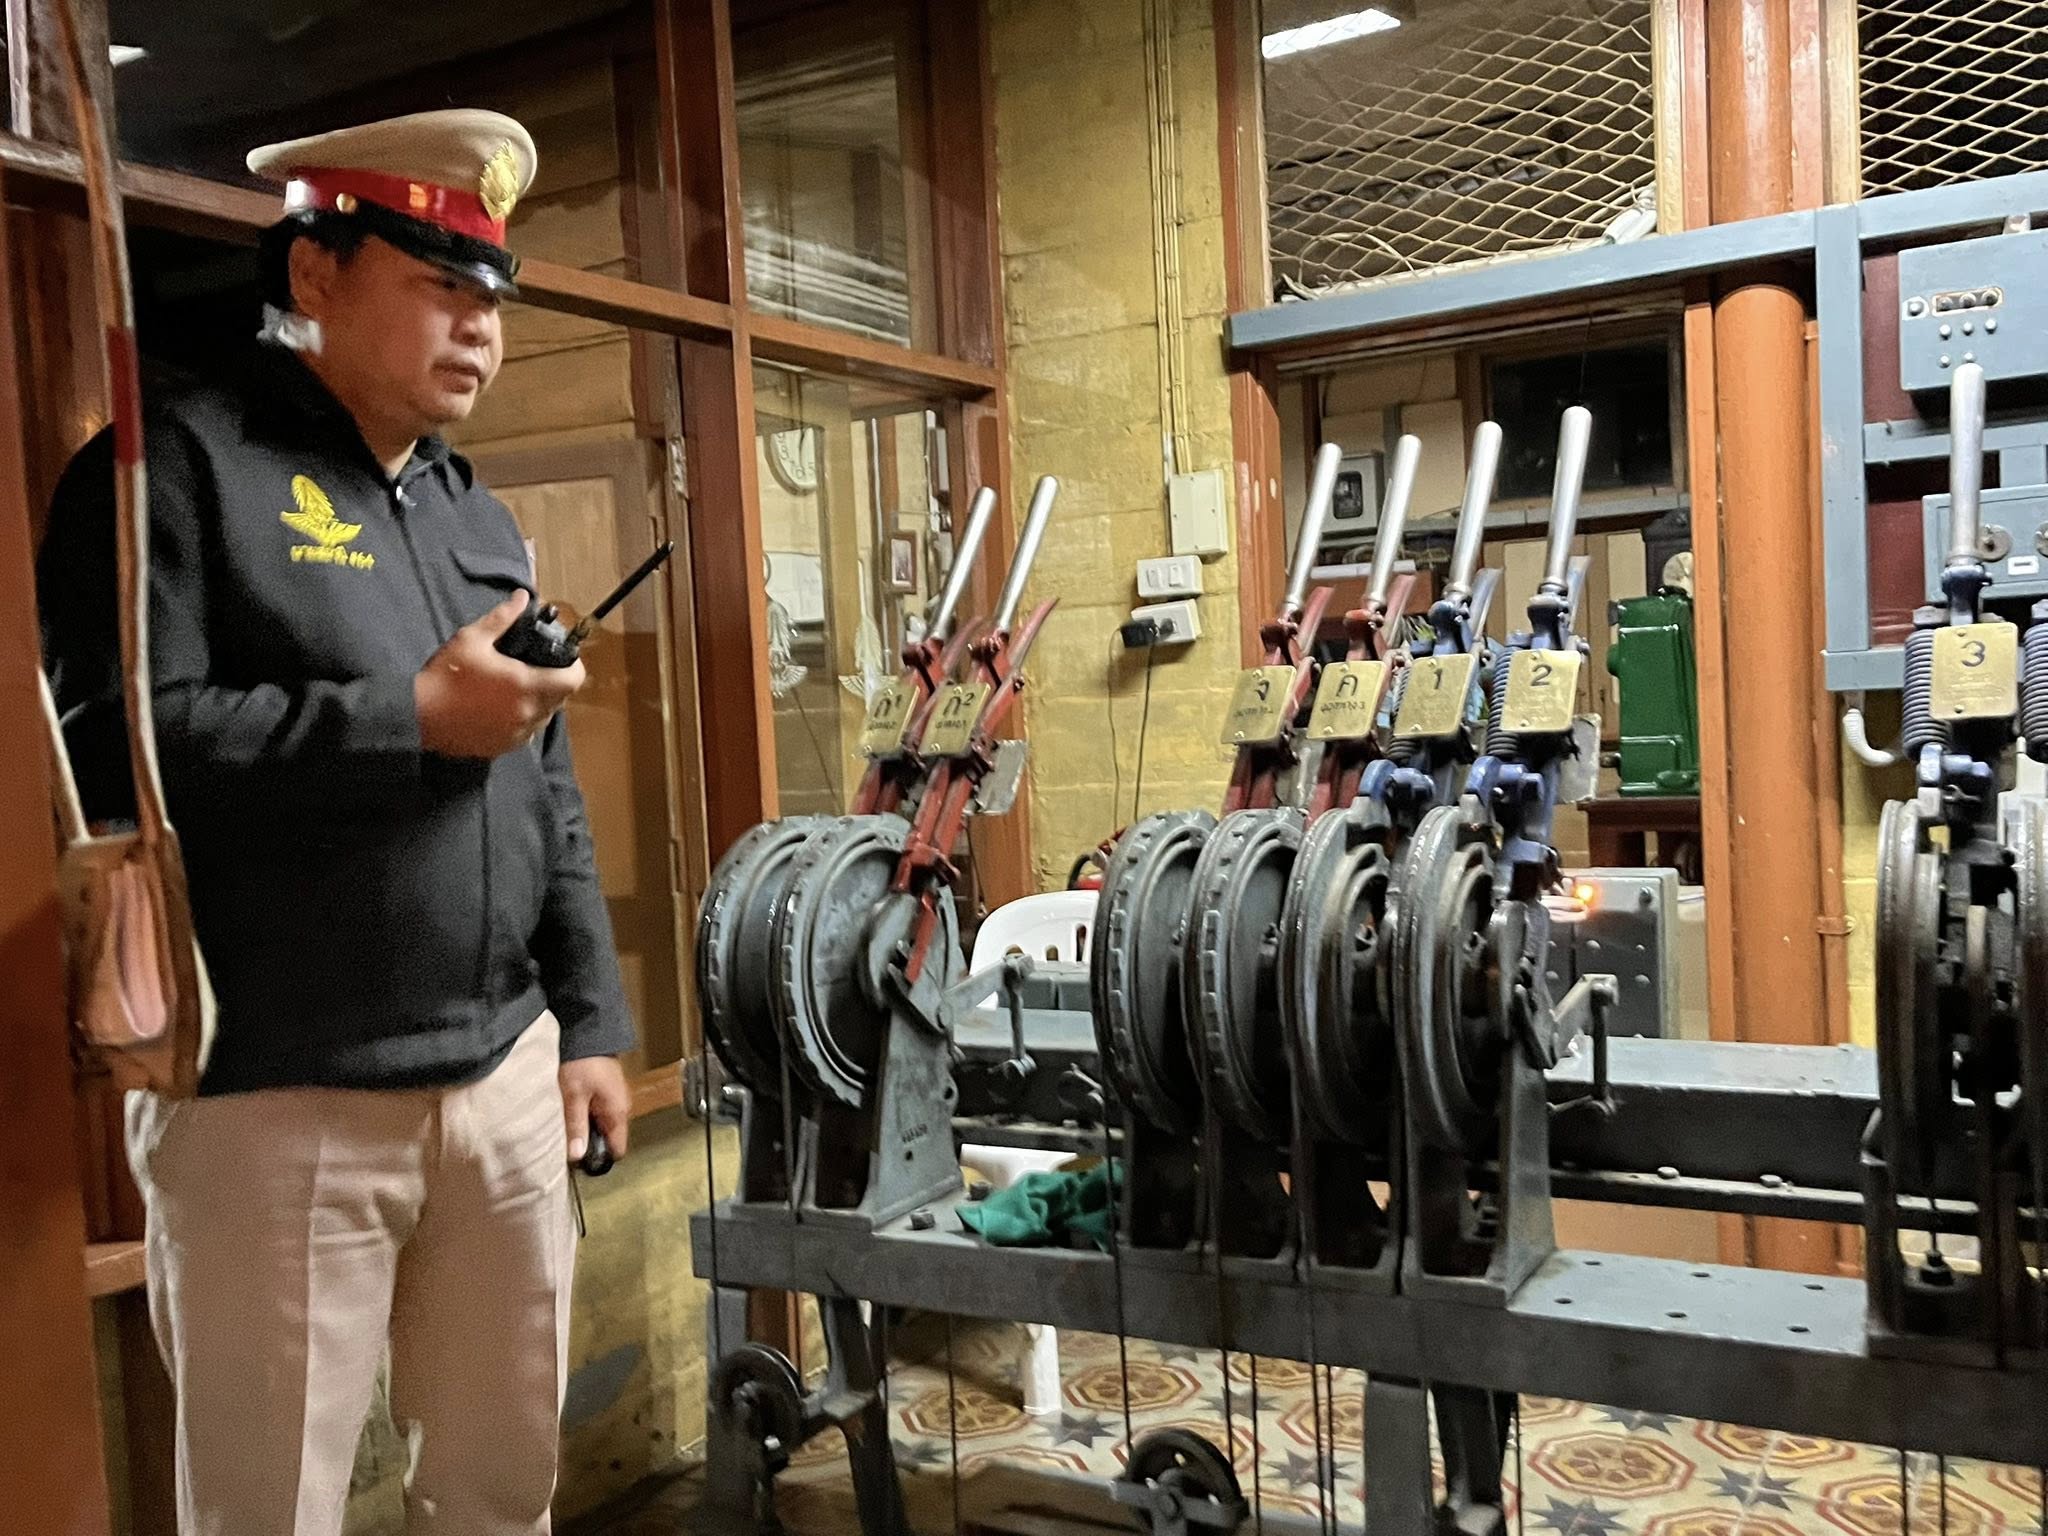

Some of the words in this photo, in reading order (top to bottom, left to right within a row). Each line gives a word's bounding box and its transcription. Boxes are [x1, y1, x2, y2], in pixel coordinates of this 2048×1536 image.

[1960, 640, 1986, 668] 3
[1433, 668, 1443, 690] 1
[1530, 664, 1553, 687] 2
